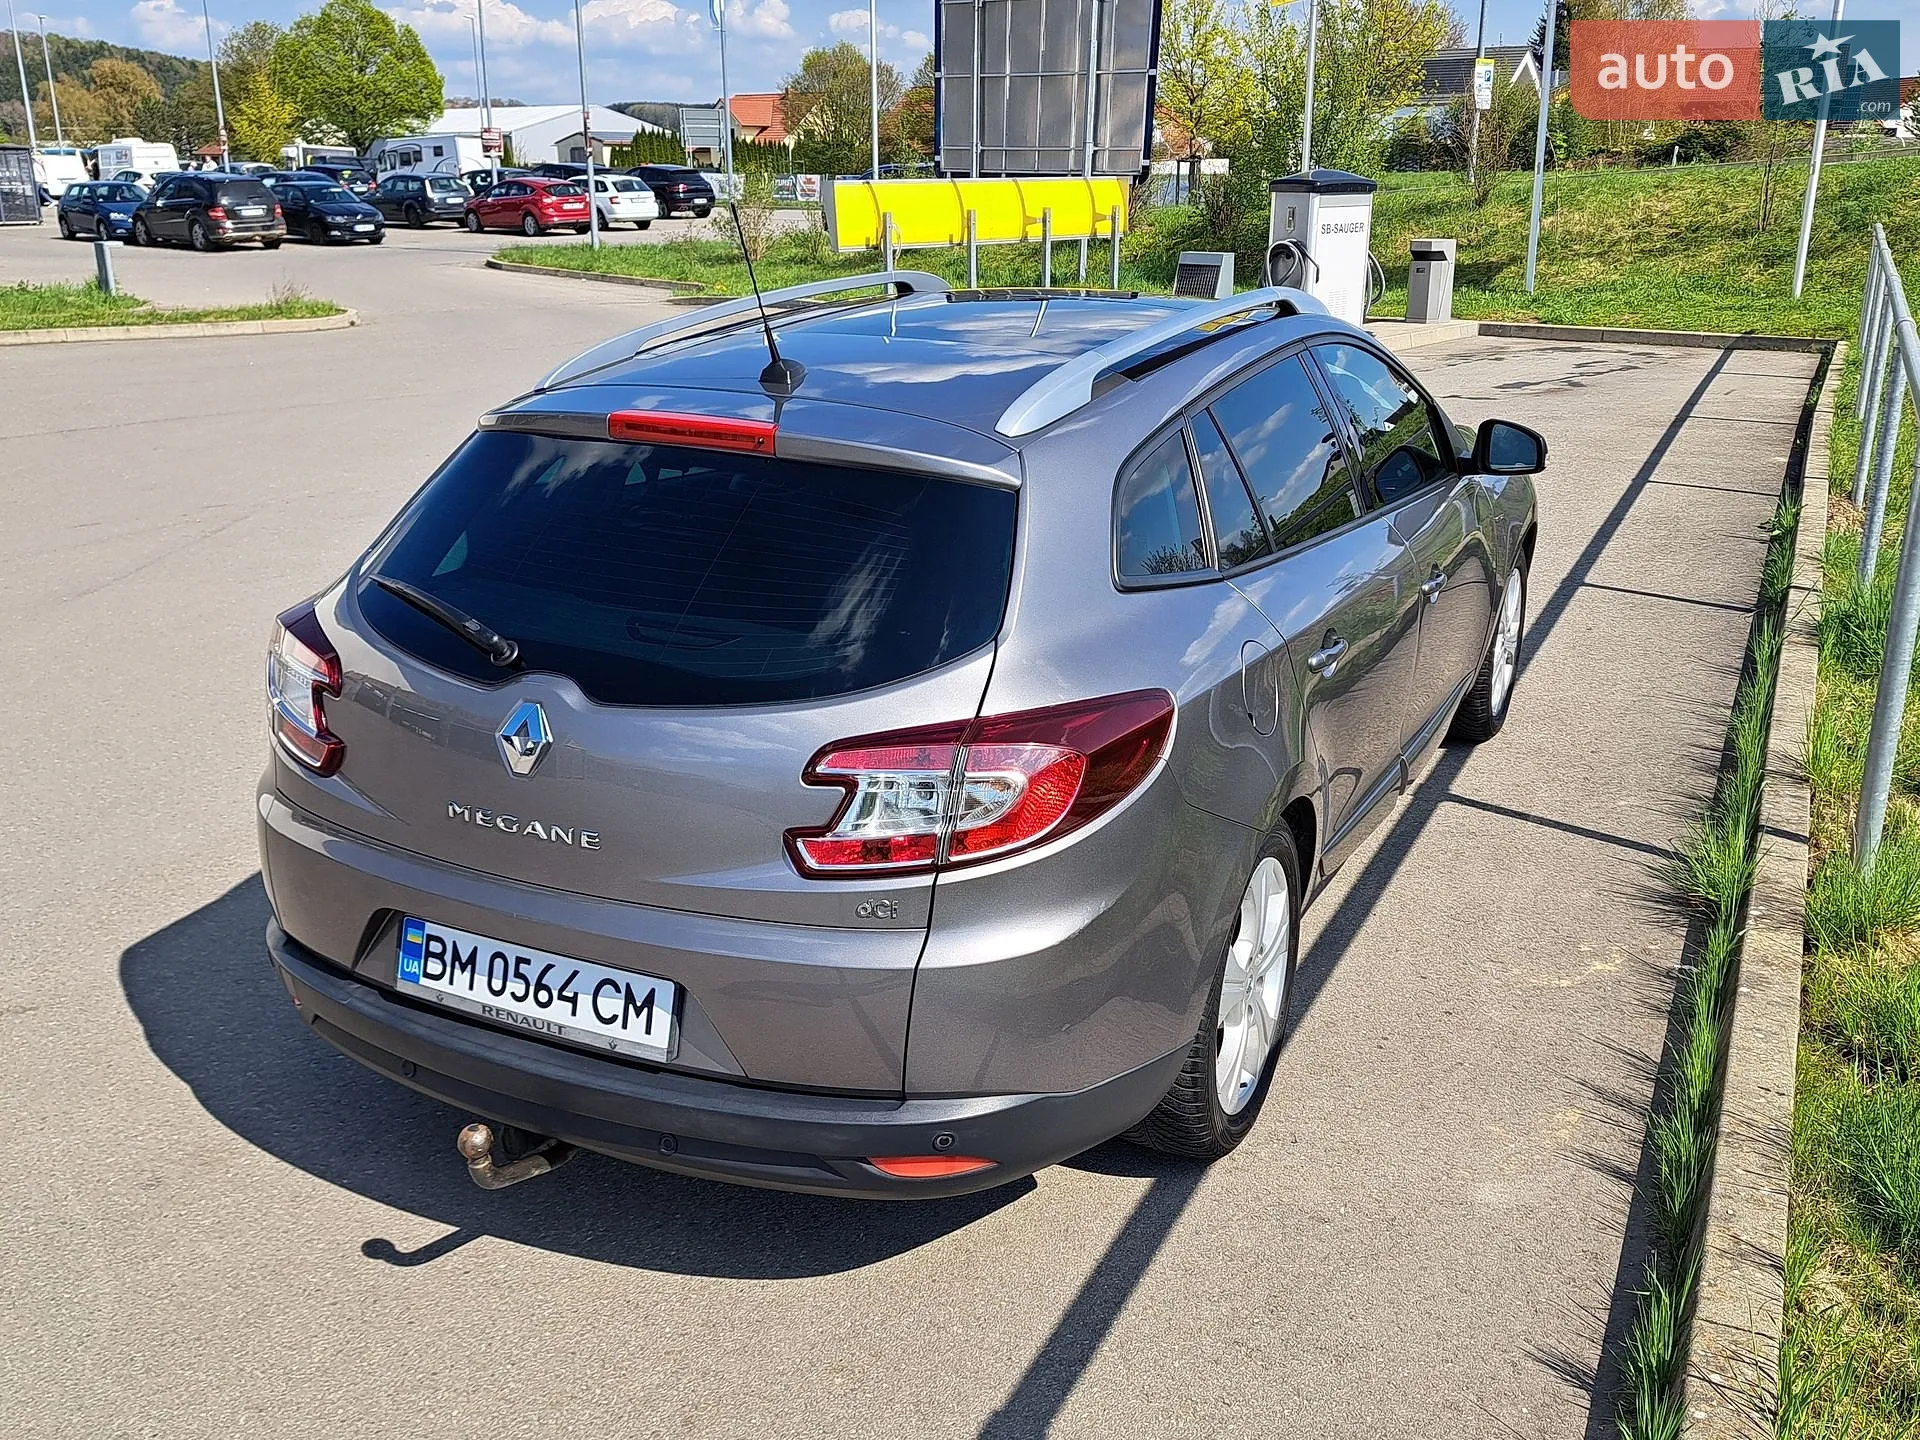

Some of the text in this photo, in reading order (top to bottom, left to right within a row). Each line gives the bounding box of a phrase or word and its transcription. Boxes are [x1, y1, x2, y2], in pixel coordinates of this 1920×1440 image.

[1321, 222, 1365, 235] SB-SAUGER
[448, 800, 601, 850] MEGANE
[855, 898, 899, 919] dCi
[404, 958, 420, 975] UA
[422, 933, 656, 1035] BM 0564 CM
[481, 1005, 567, 1036] RENAULT
